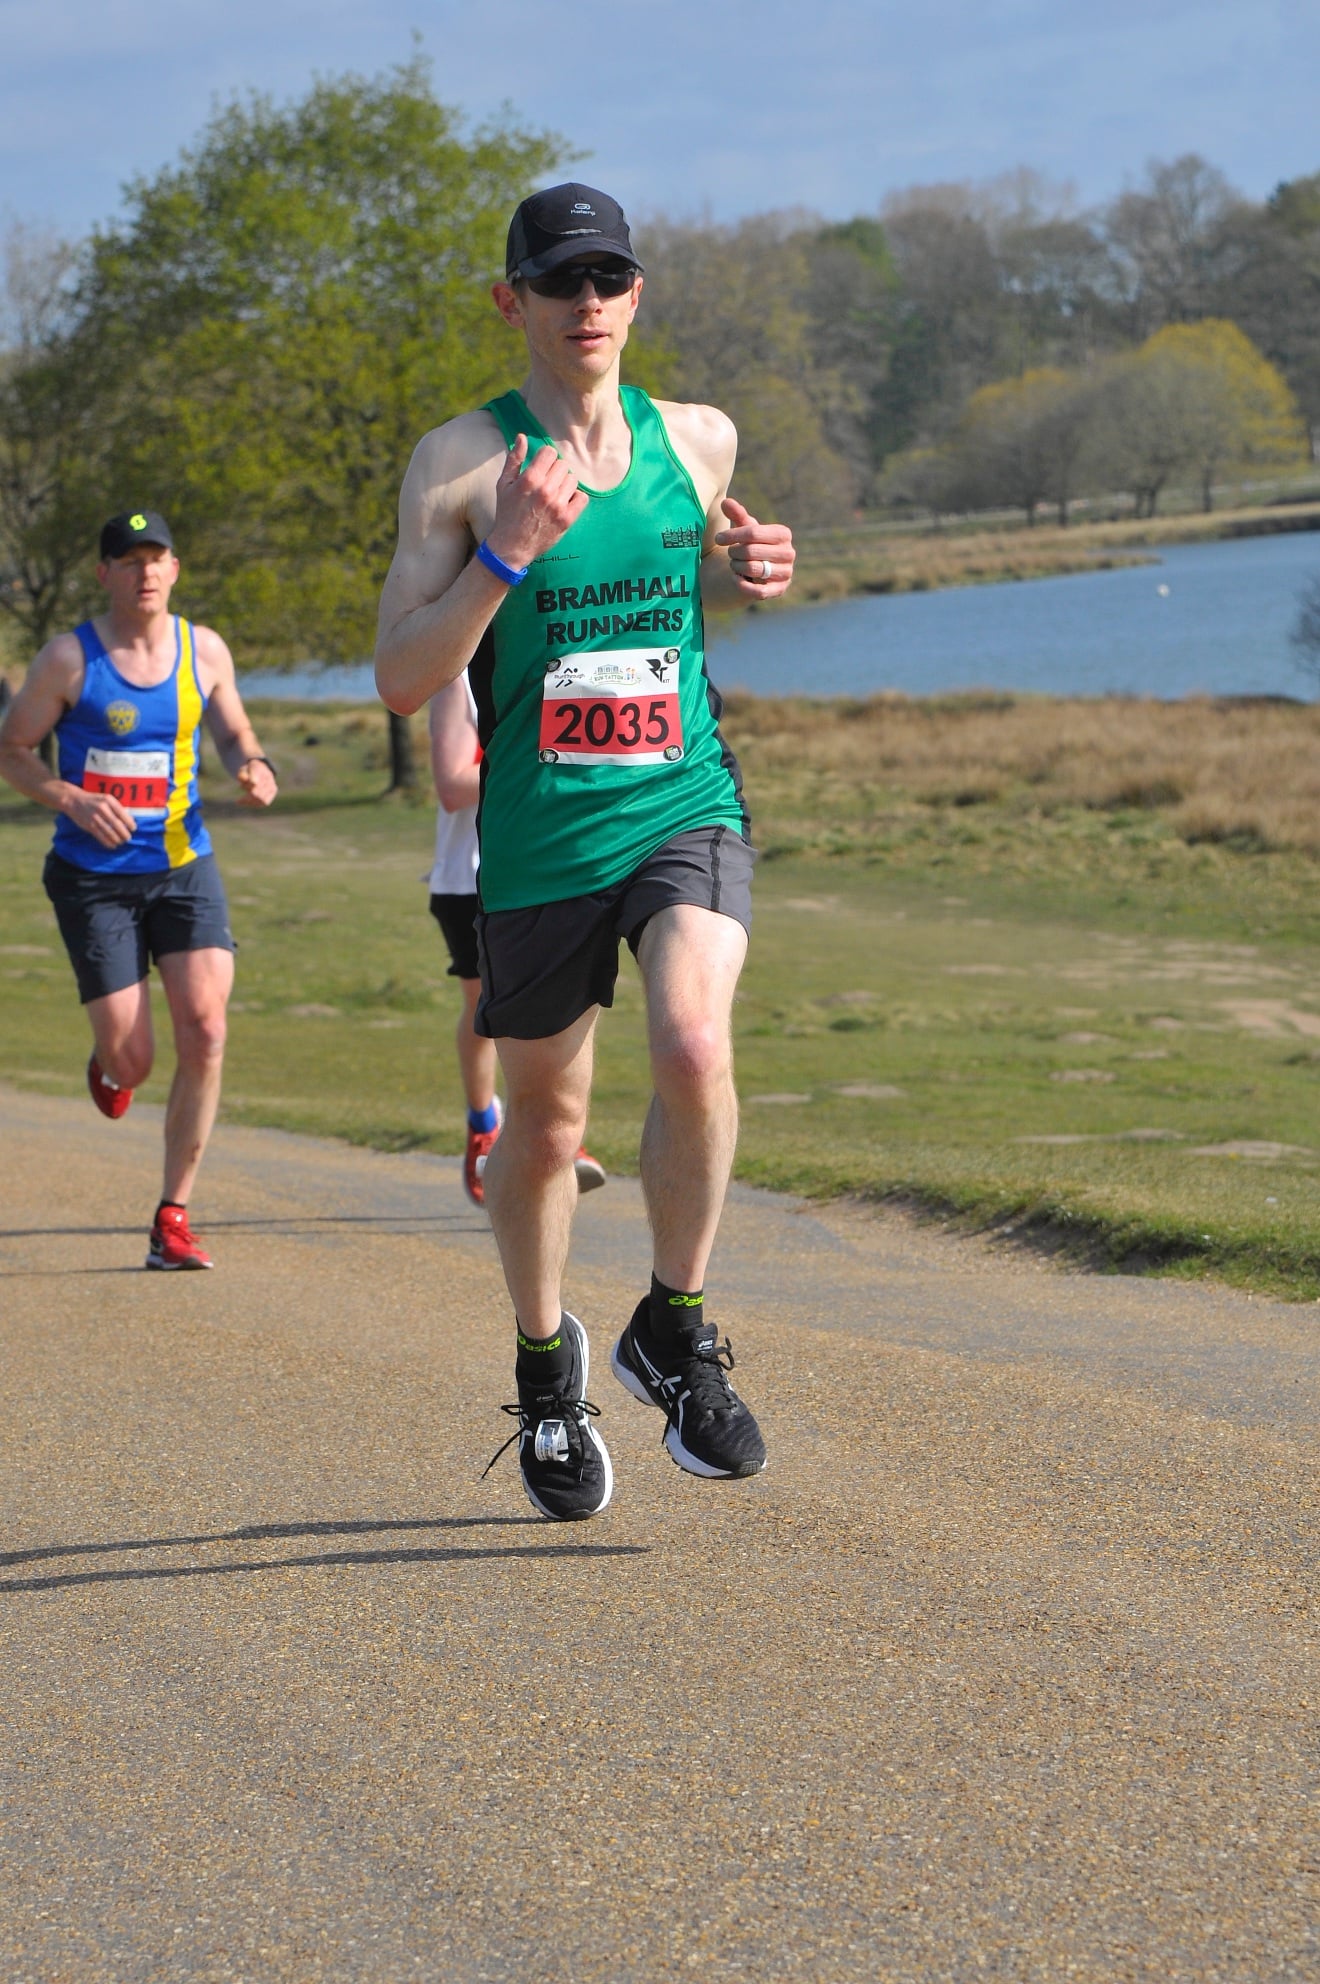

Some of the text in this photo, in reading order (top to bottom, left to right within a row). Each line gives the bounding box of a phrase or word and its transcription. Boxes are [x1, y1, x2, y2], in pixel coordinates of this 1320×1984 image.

[535, 574, 690, 613] BRAMHALL
[546, 608, 683, 646] RUNNERS
[553, 700, 669, 747] 2035
